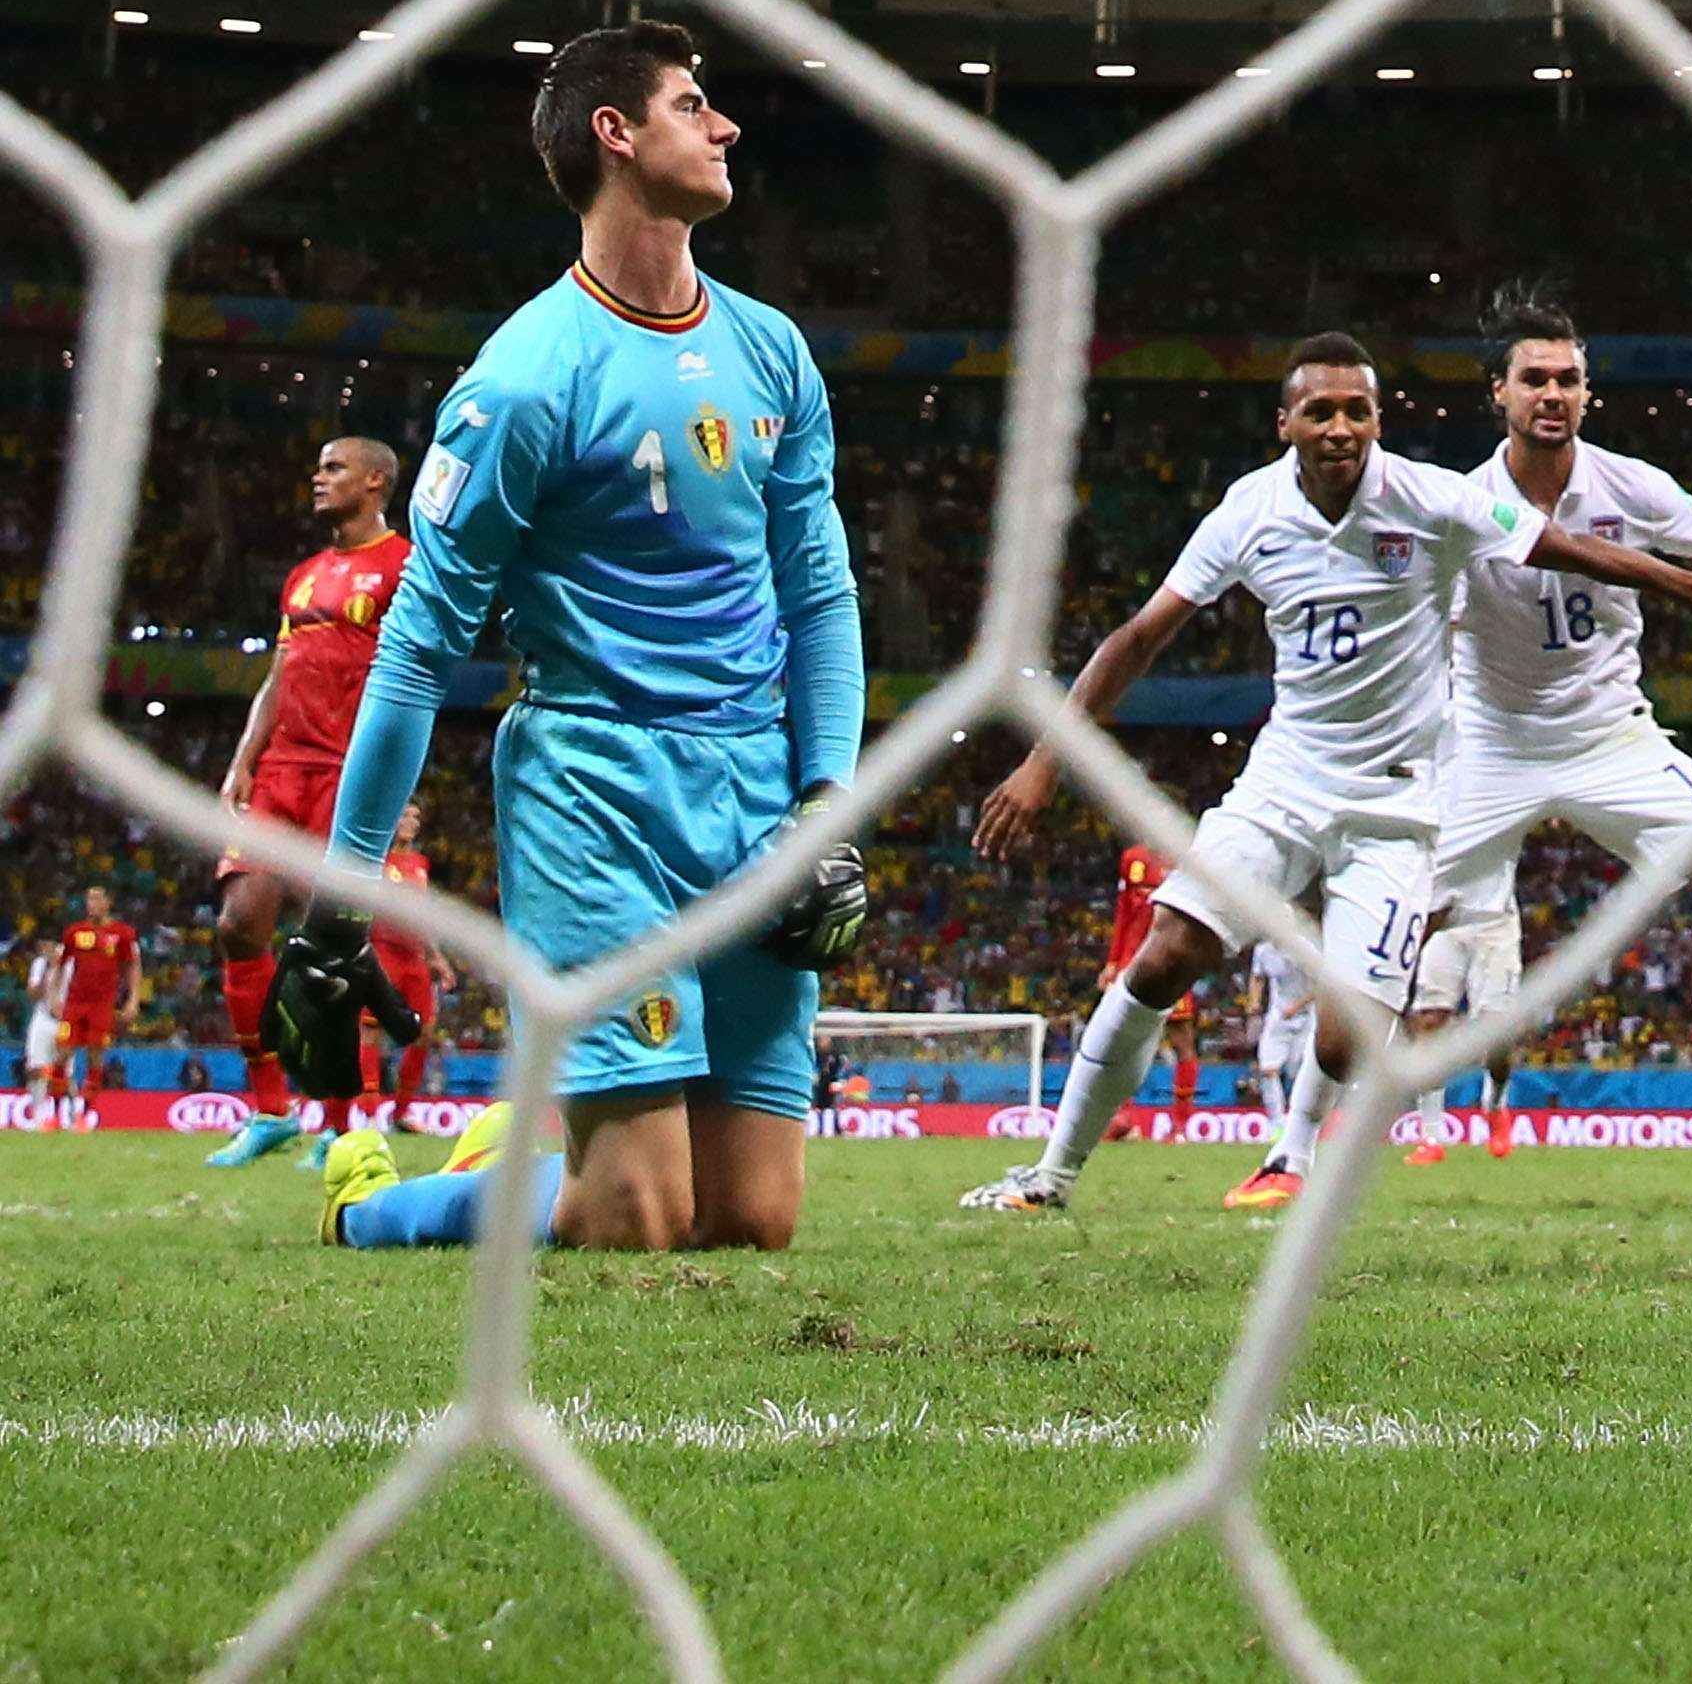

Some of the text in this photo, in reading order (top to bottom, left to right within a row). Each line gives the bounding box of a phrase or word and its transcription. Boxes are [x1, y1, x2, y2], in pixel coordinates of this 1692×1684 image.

[632, 429, 669, 515] 1
[1298, 600, 1364, 665] 16
[1538, 591, 1597, 651] 18
